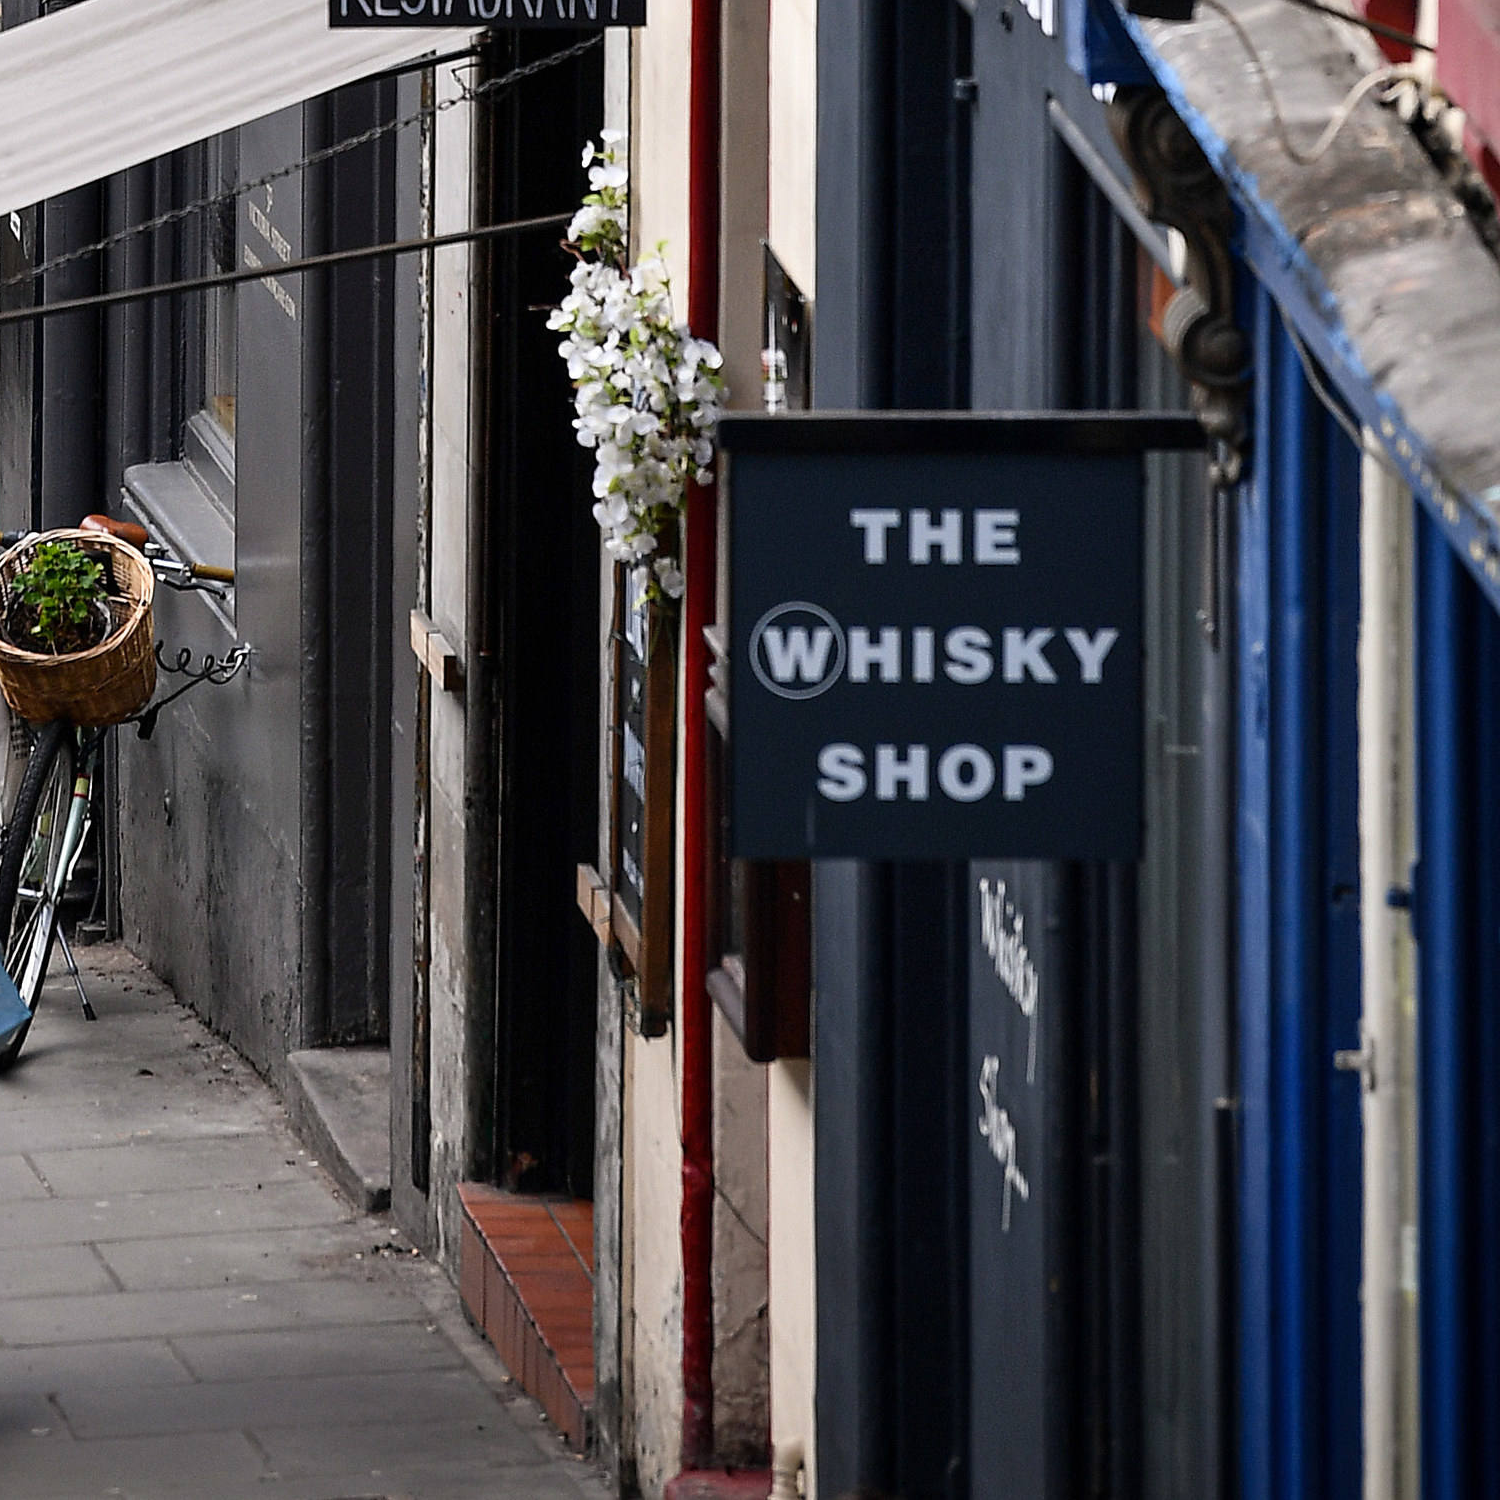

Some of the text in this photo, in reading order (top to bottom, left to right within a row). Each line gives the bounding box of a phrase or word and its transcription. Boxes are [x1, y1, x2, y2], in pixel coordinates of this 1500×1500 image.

[849, 507, 1022, 566] THE
[759, 624, 1120, 685] WHISKY
[816, 742, 1055, 803] SHOP
